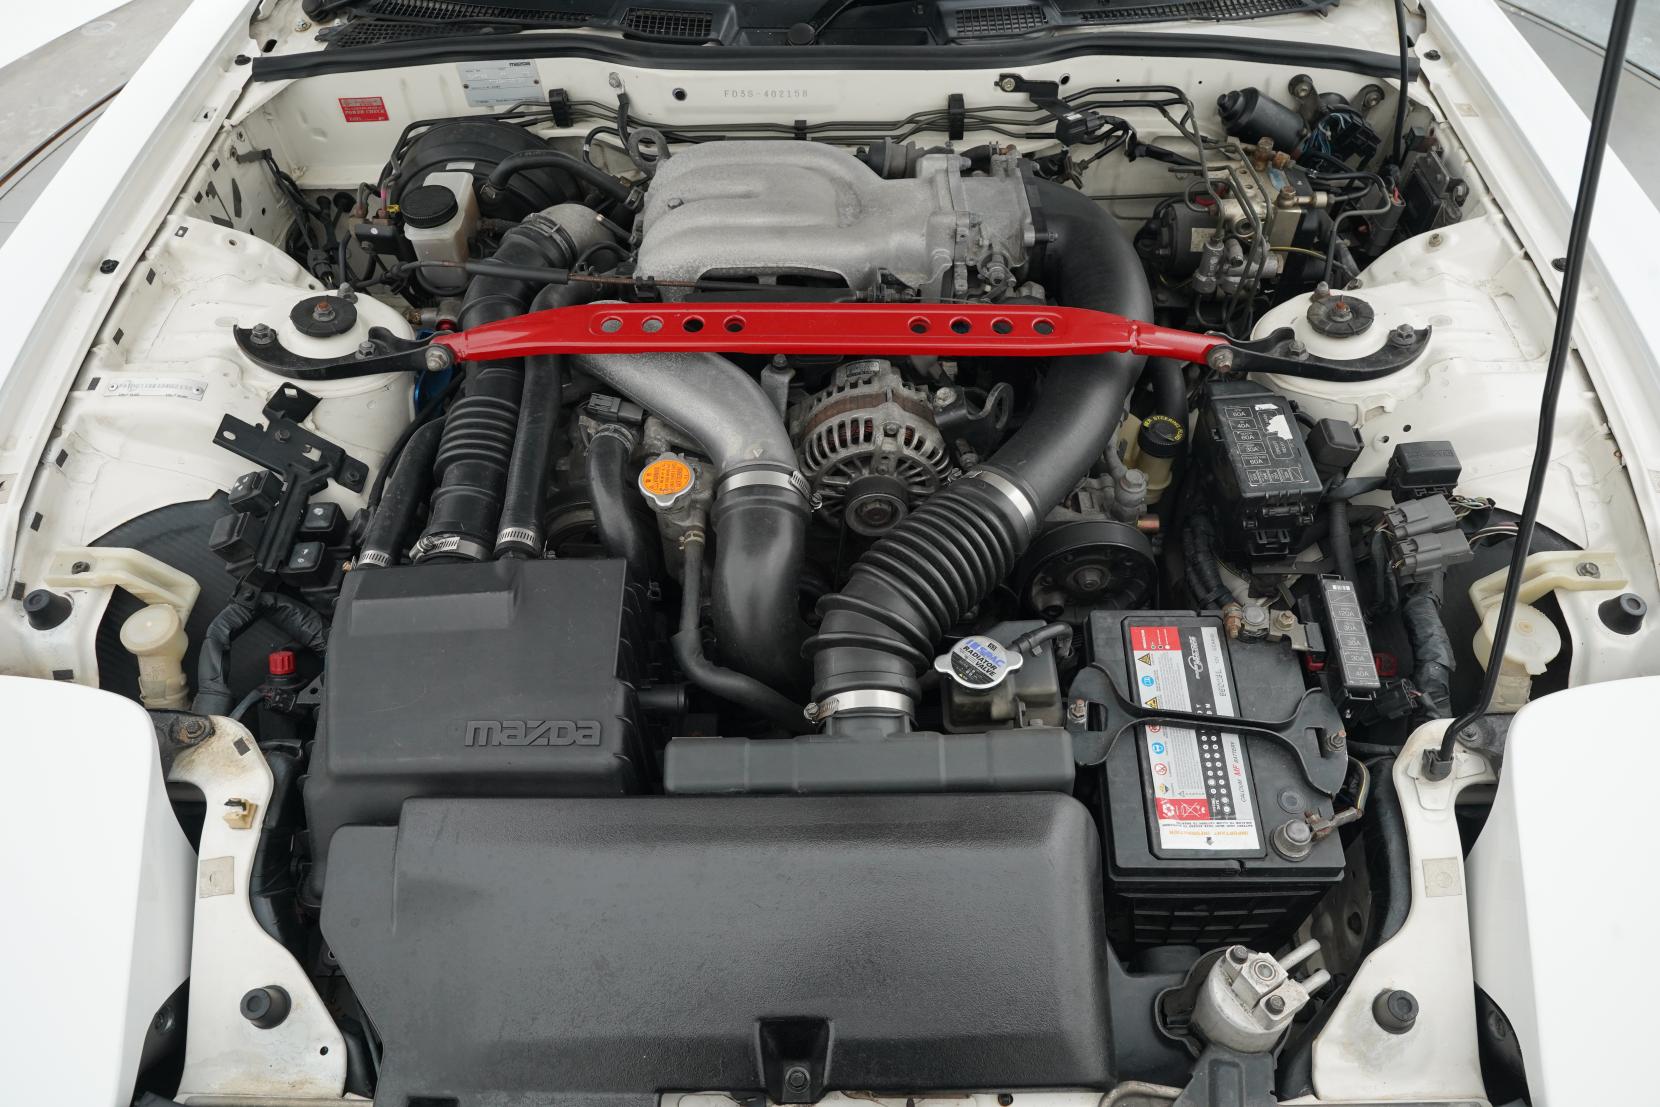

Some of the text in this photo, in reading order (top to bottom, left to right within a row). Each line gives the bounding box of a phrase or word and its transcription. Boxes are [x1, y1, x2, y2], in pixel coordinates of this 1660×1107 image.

[963, 645, 998, 671] RADIATOR
[975, 661, 997, 677] VALVE
[464, 720, 602, 747] mazda
[1232, 763, 1241, 777] MF
